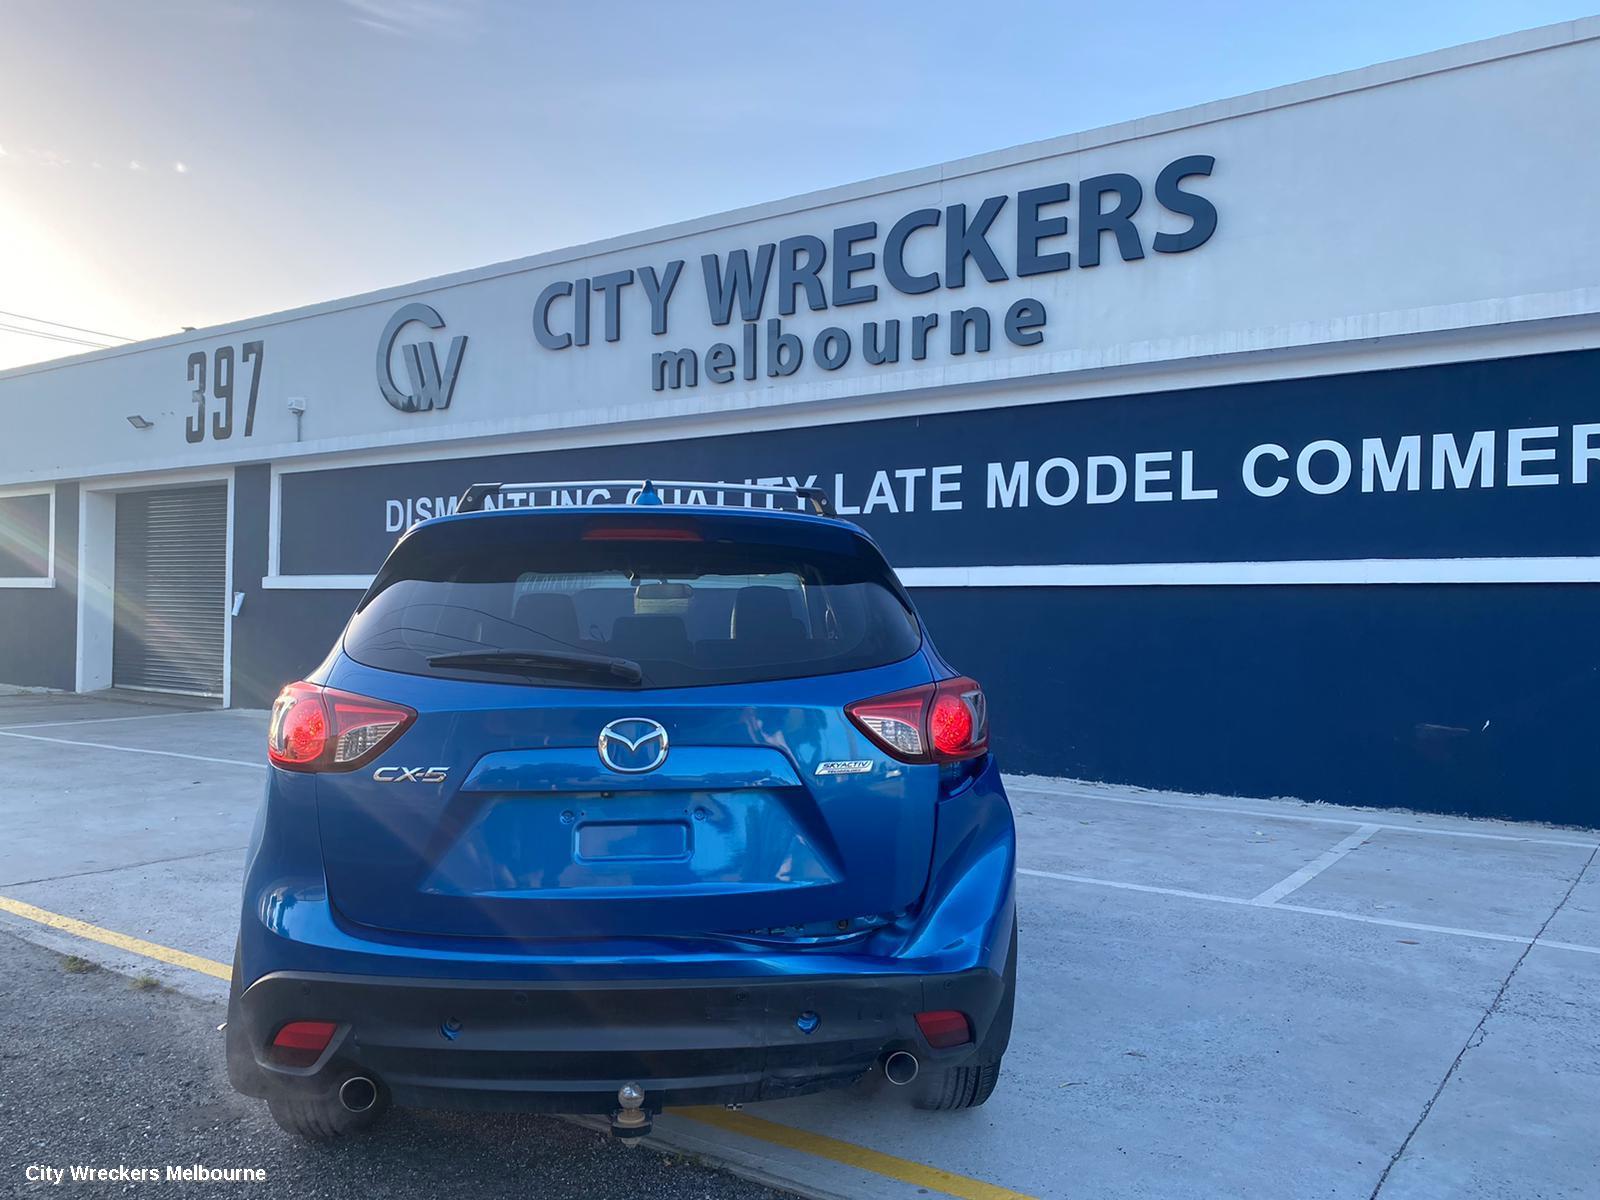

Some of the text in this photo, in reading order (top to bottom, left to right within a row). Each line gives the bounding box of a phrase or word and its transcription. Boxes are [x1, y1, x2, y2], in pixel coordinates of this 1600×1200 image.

[534, 154, 1218, 351] CITY WRECKERS
[651, 297, 1047, 392] melbourne
[185, 340, 264, 444] 397
[385, 487, 611, 533] DISMNTIN
[834, 464, 963, 516] LATE
[986, 450, 1219, 510] MODEL
[372, 766, 451, 783] CX-5
[823, 761, 867, 769] SKYACTIV
